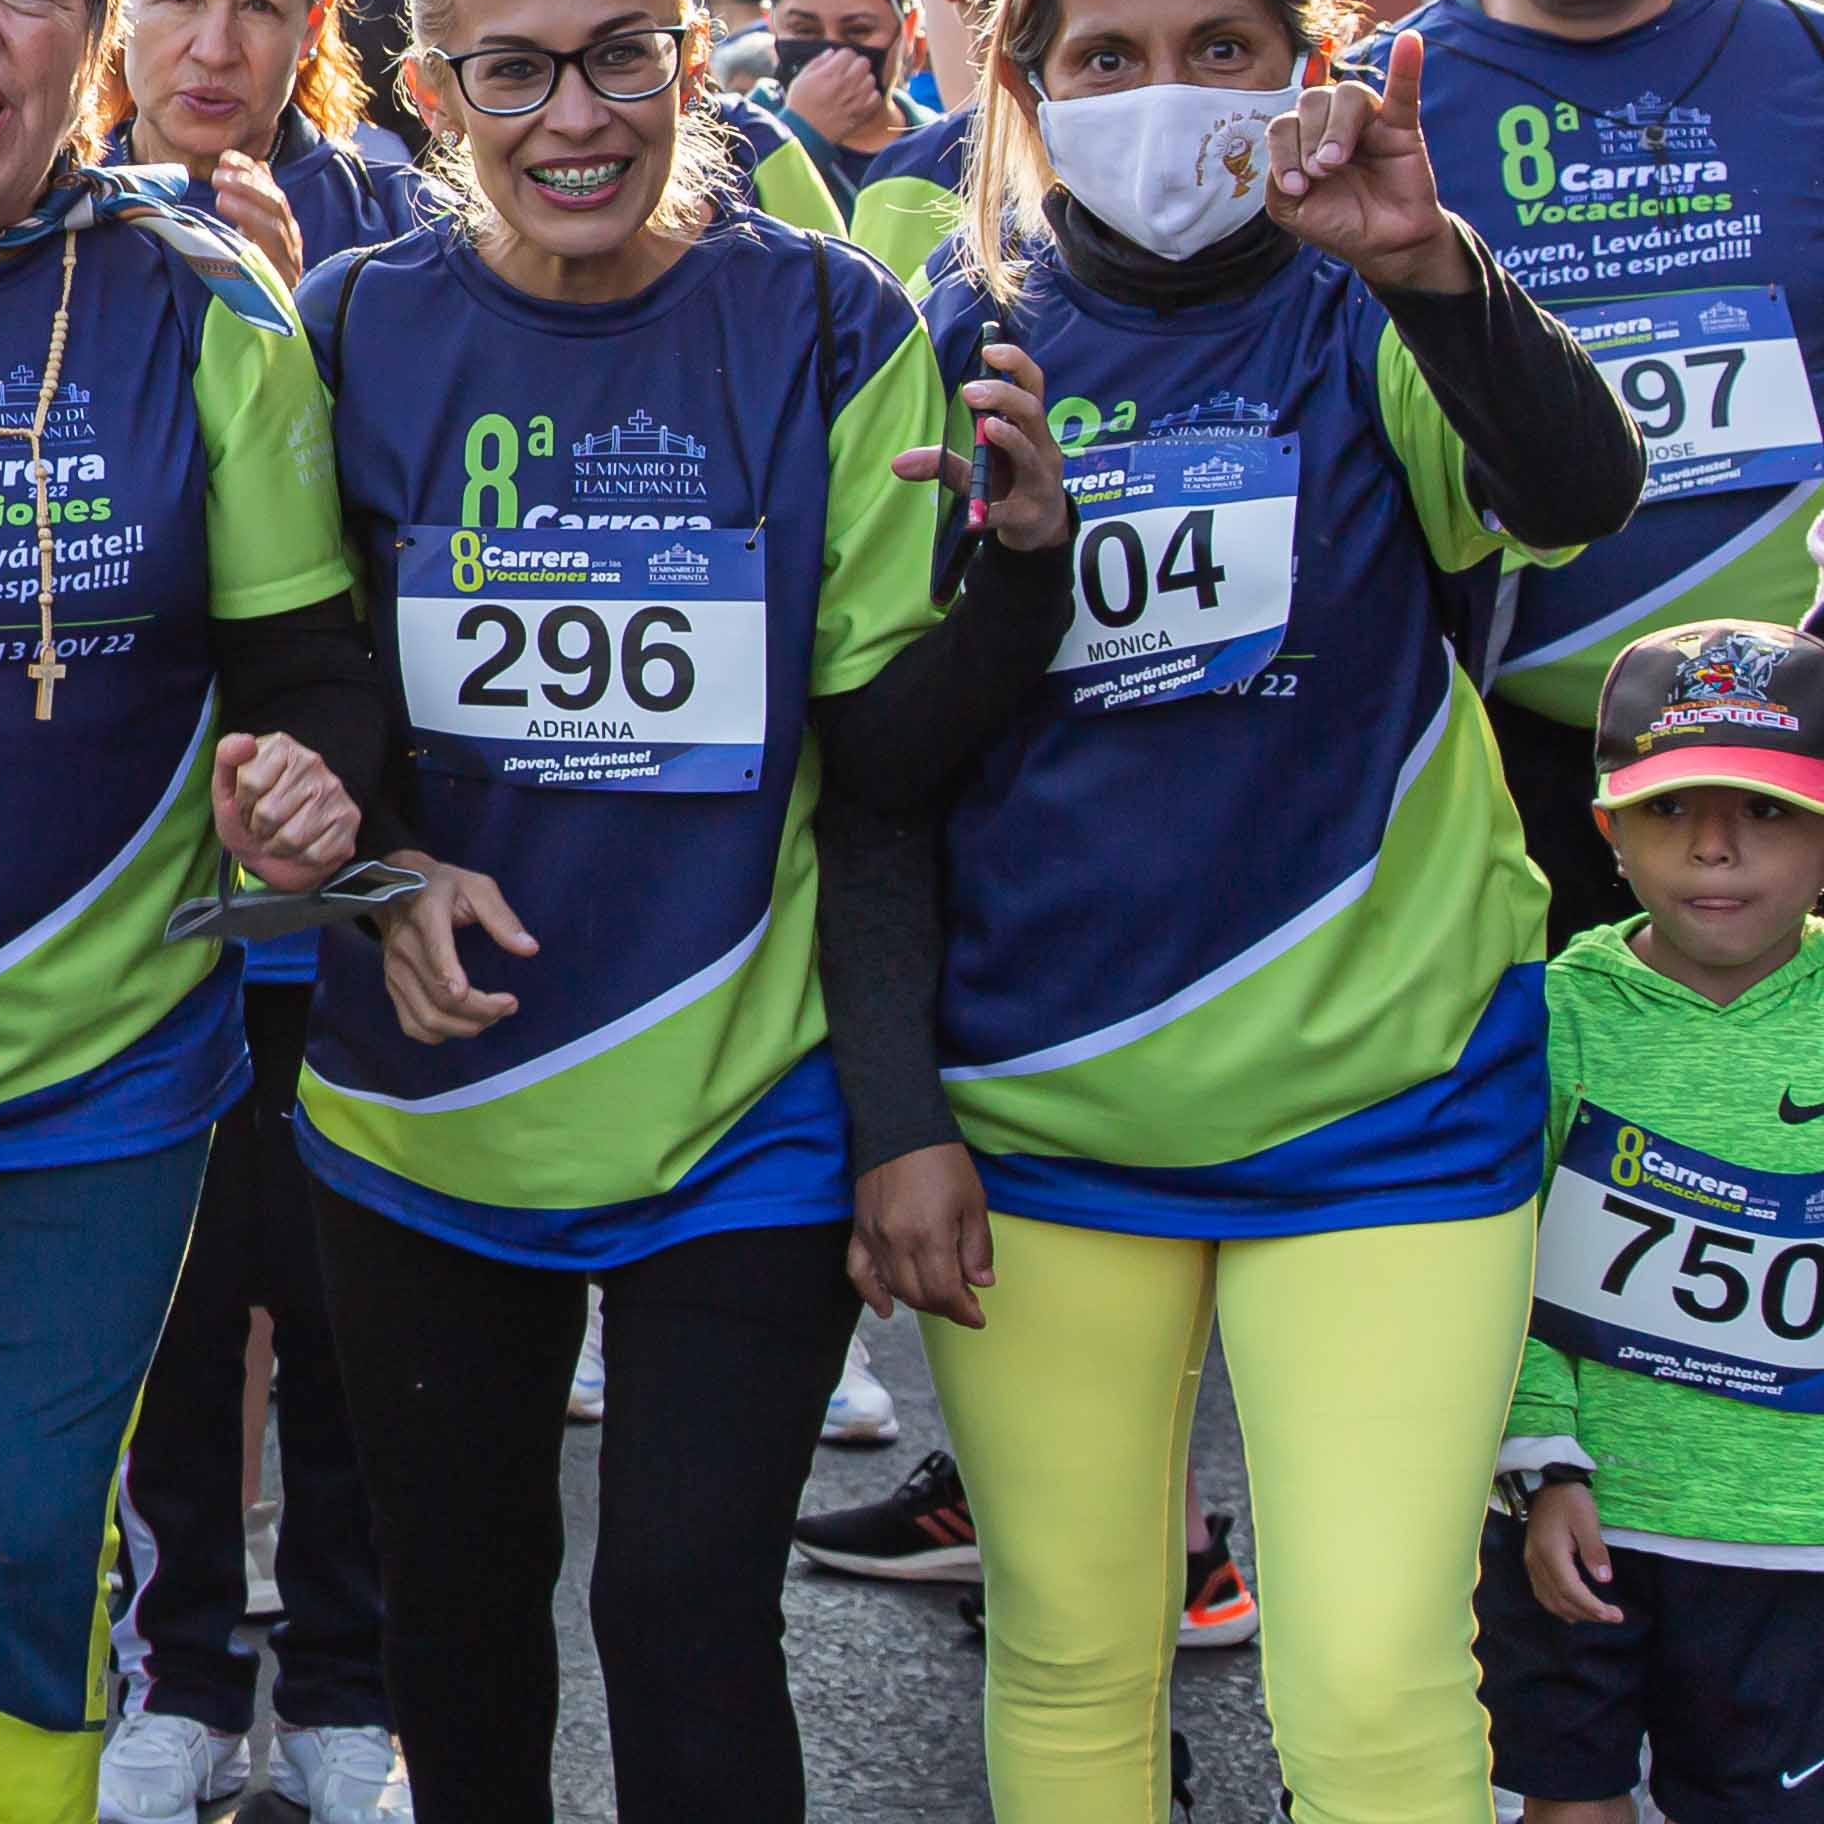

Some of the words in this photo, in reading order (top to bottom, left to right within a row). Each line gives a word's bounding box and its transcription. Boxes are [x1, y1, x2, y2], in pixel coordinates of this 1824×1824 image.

[1560, 160, 1728, 193] Carrera
[1517, 192, 1733, 227] Vocaciones
[1593, 215, 1762, 257] Levántate!!
[1596, 261, 1620, 278] te
[1629, 239, 1752, 276] espera!!!!
[574, 461, 675, 477] SEMINARIO
[679, 462, 704, 477] DE
[1062, 469, 1125, 493] rrera
[28, 485, 68, 499] 222
[574, 480, 707, 496] TLALNEPANTLA
[1126, 484, 1154, 498] 2022
[482, 547, 590, 569] Carrera
[485, 569, 587, 583] Vocaciones
[591, 572, 621, 583] 2022
[104, 633, 135, 654] 22
[1087, 629, 1173, 662] MONICA
[456, 604, 696, 714] 296
[1073, 678, 1119, 705] ¡Joven,
[1120, 654, 1197, 689] levántate!
[1103, 686, 1141, 709] ¡Cristo
[1143, 682, 1157, 698] te
[1158, 667, 1206, 692] espera!
[1260, 673, 1298, 697] 22
[526, 720, 636, 740] ADRIANA
[1650, 706, 1799, 731] JUSTICE
[504, 755, 561, 772] ¡Joven,
[564, 750, 651, 769] levántate!
[538, 769, 585, 784] ¡Cristo
[587, 767, 602, 781] te
[605, 764, 660, 780] espera!
[1642, 1150, 1748, 1201] Carrera
[1642, 1171, 1743, 1214] Vocaciones
[1745, 1207, 1777, 1221] 2022
[1599, 1192, 1824, 1341] 750
[1618, 1345, 1680, 1368] ¡Joven,
[1684, 1357, 1777, 1383] levántate!
[1653, 1366, 1704, 1383] ¡Cristo
[1706, 1373, 1722, 1386] te
[1725, 1377, 1784, 1396] espera!
